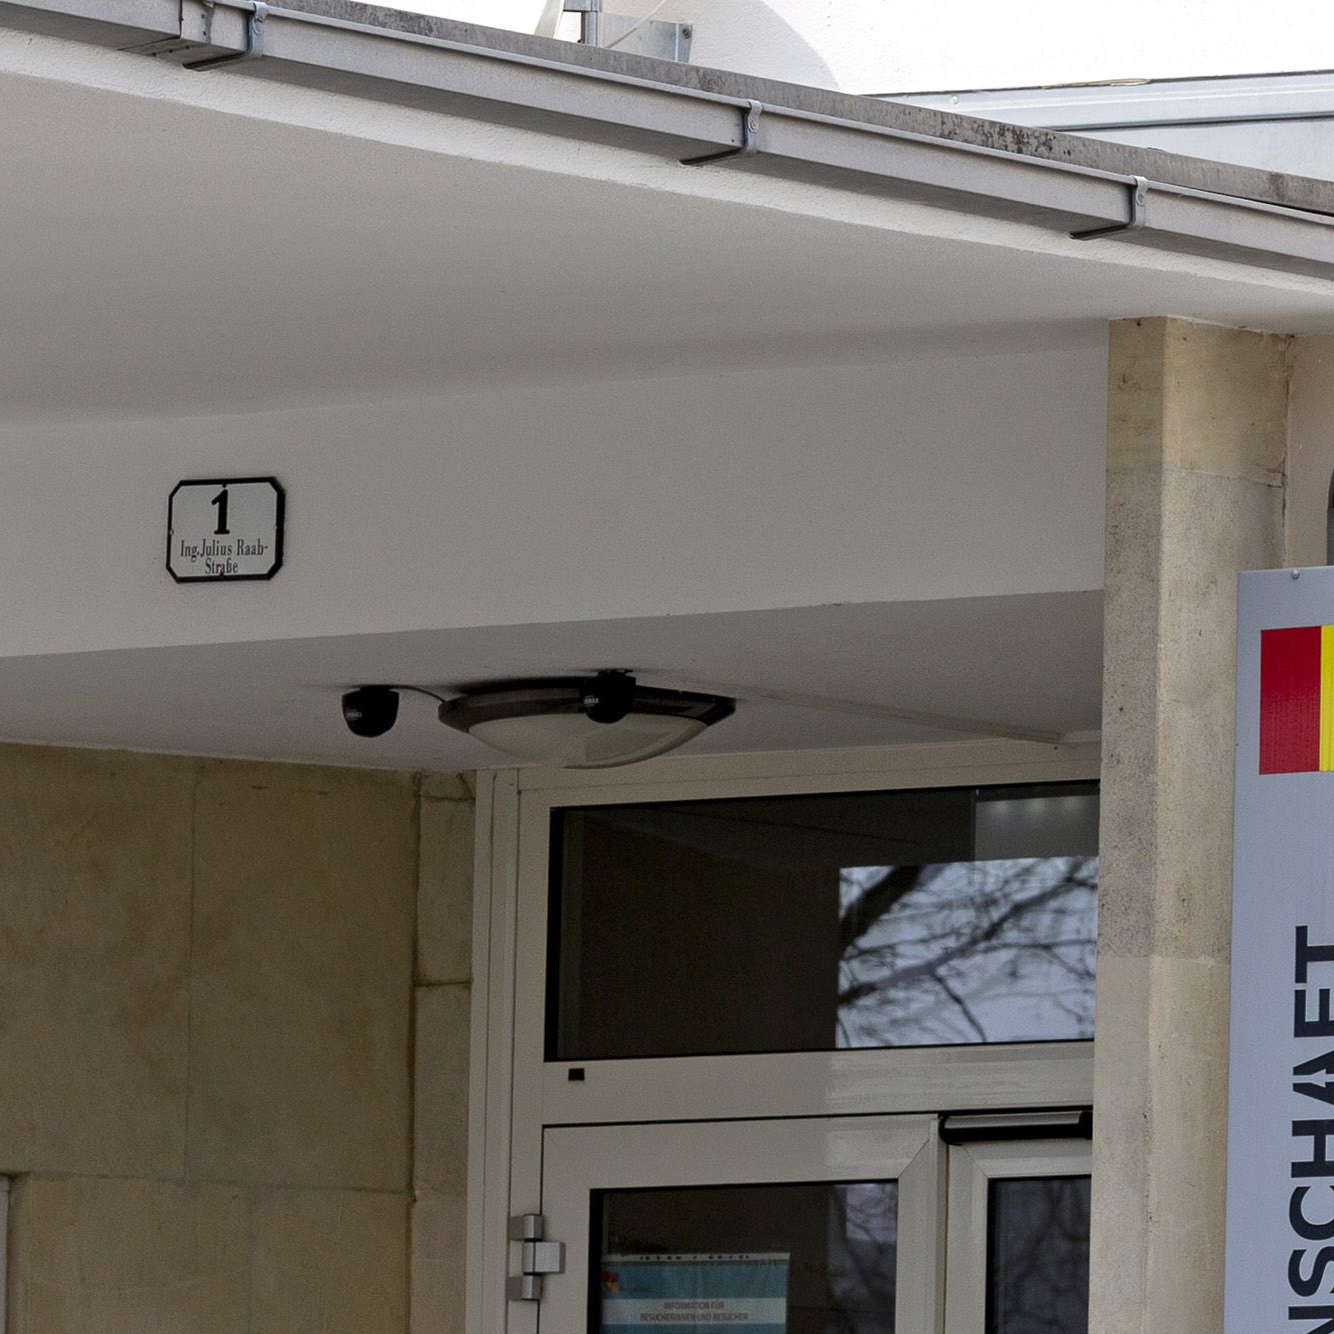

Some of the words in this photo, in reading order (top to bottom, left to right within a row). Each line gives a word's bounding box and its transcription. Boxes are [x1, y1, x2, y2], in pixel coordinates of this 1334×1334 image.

[211, 489, 230, 534] 1
[236, 538, 269, 556] Raab-
[205, 557, 238, 574] Straße
